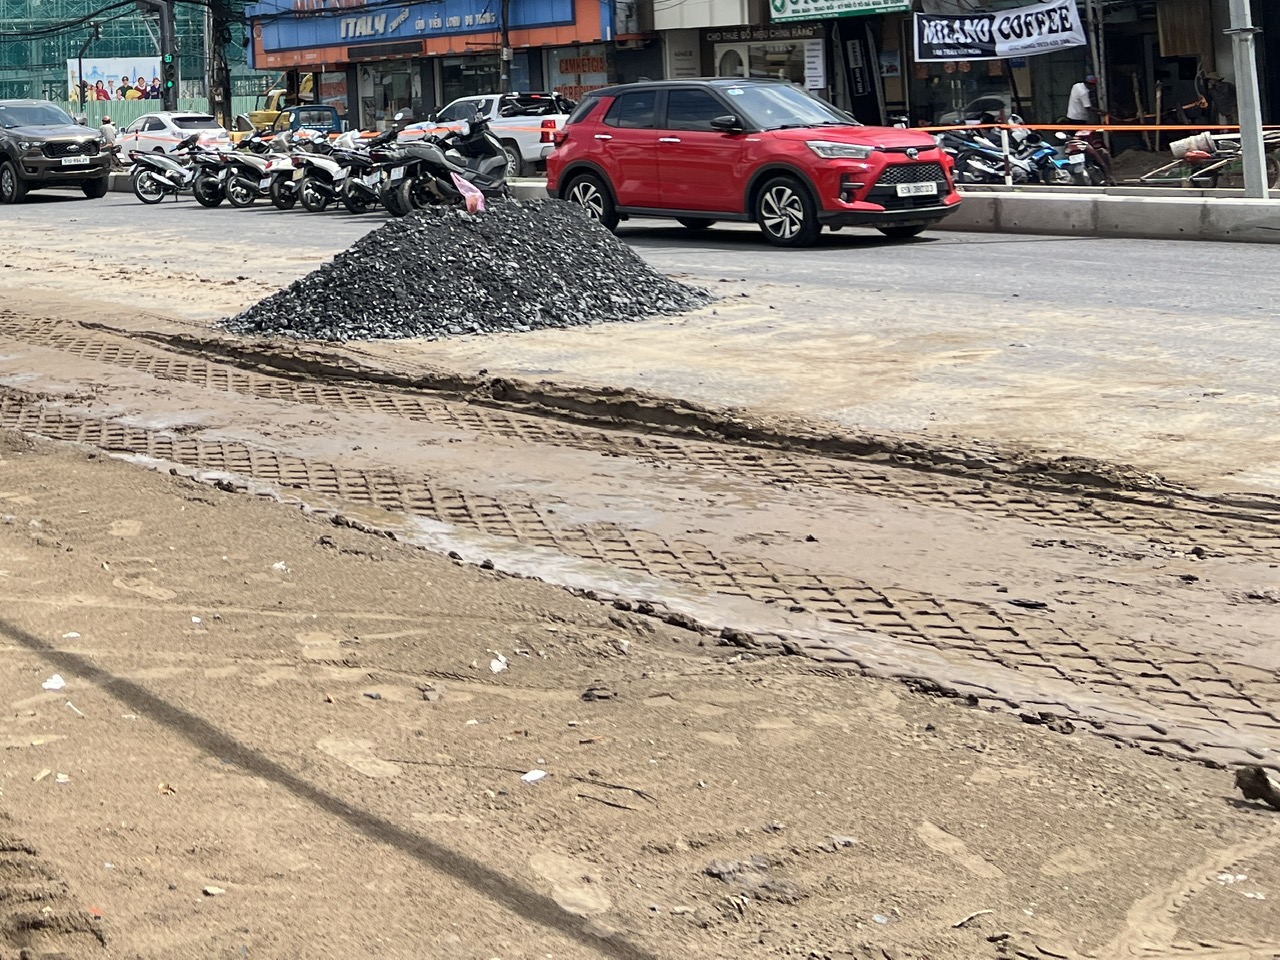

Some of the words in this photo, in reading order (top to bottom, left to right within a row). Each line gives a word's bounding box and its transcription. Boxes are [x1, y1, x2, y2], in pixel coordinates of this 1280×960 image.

[340, 14, 387, 38] ITALY
[922, 17, 991, 45] MILANO
[998, 5, 1074, 41] COFFEE
